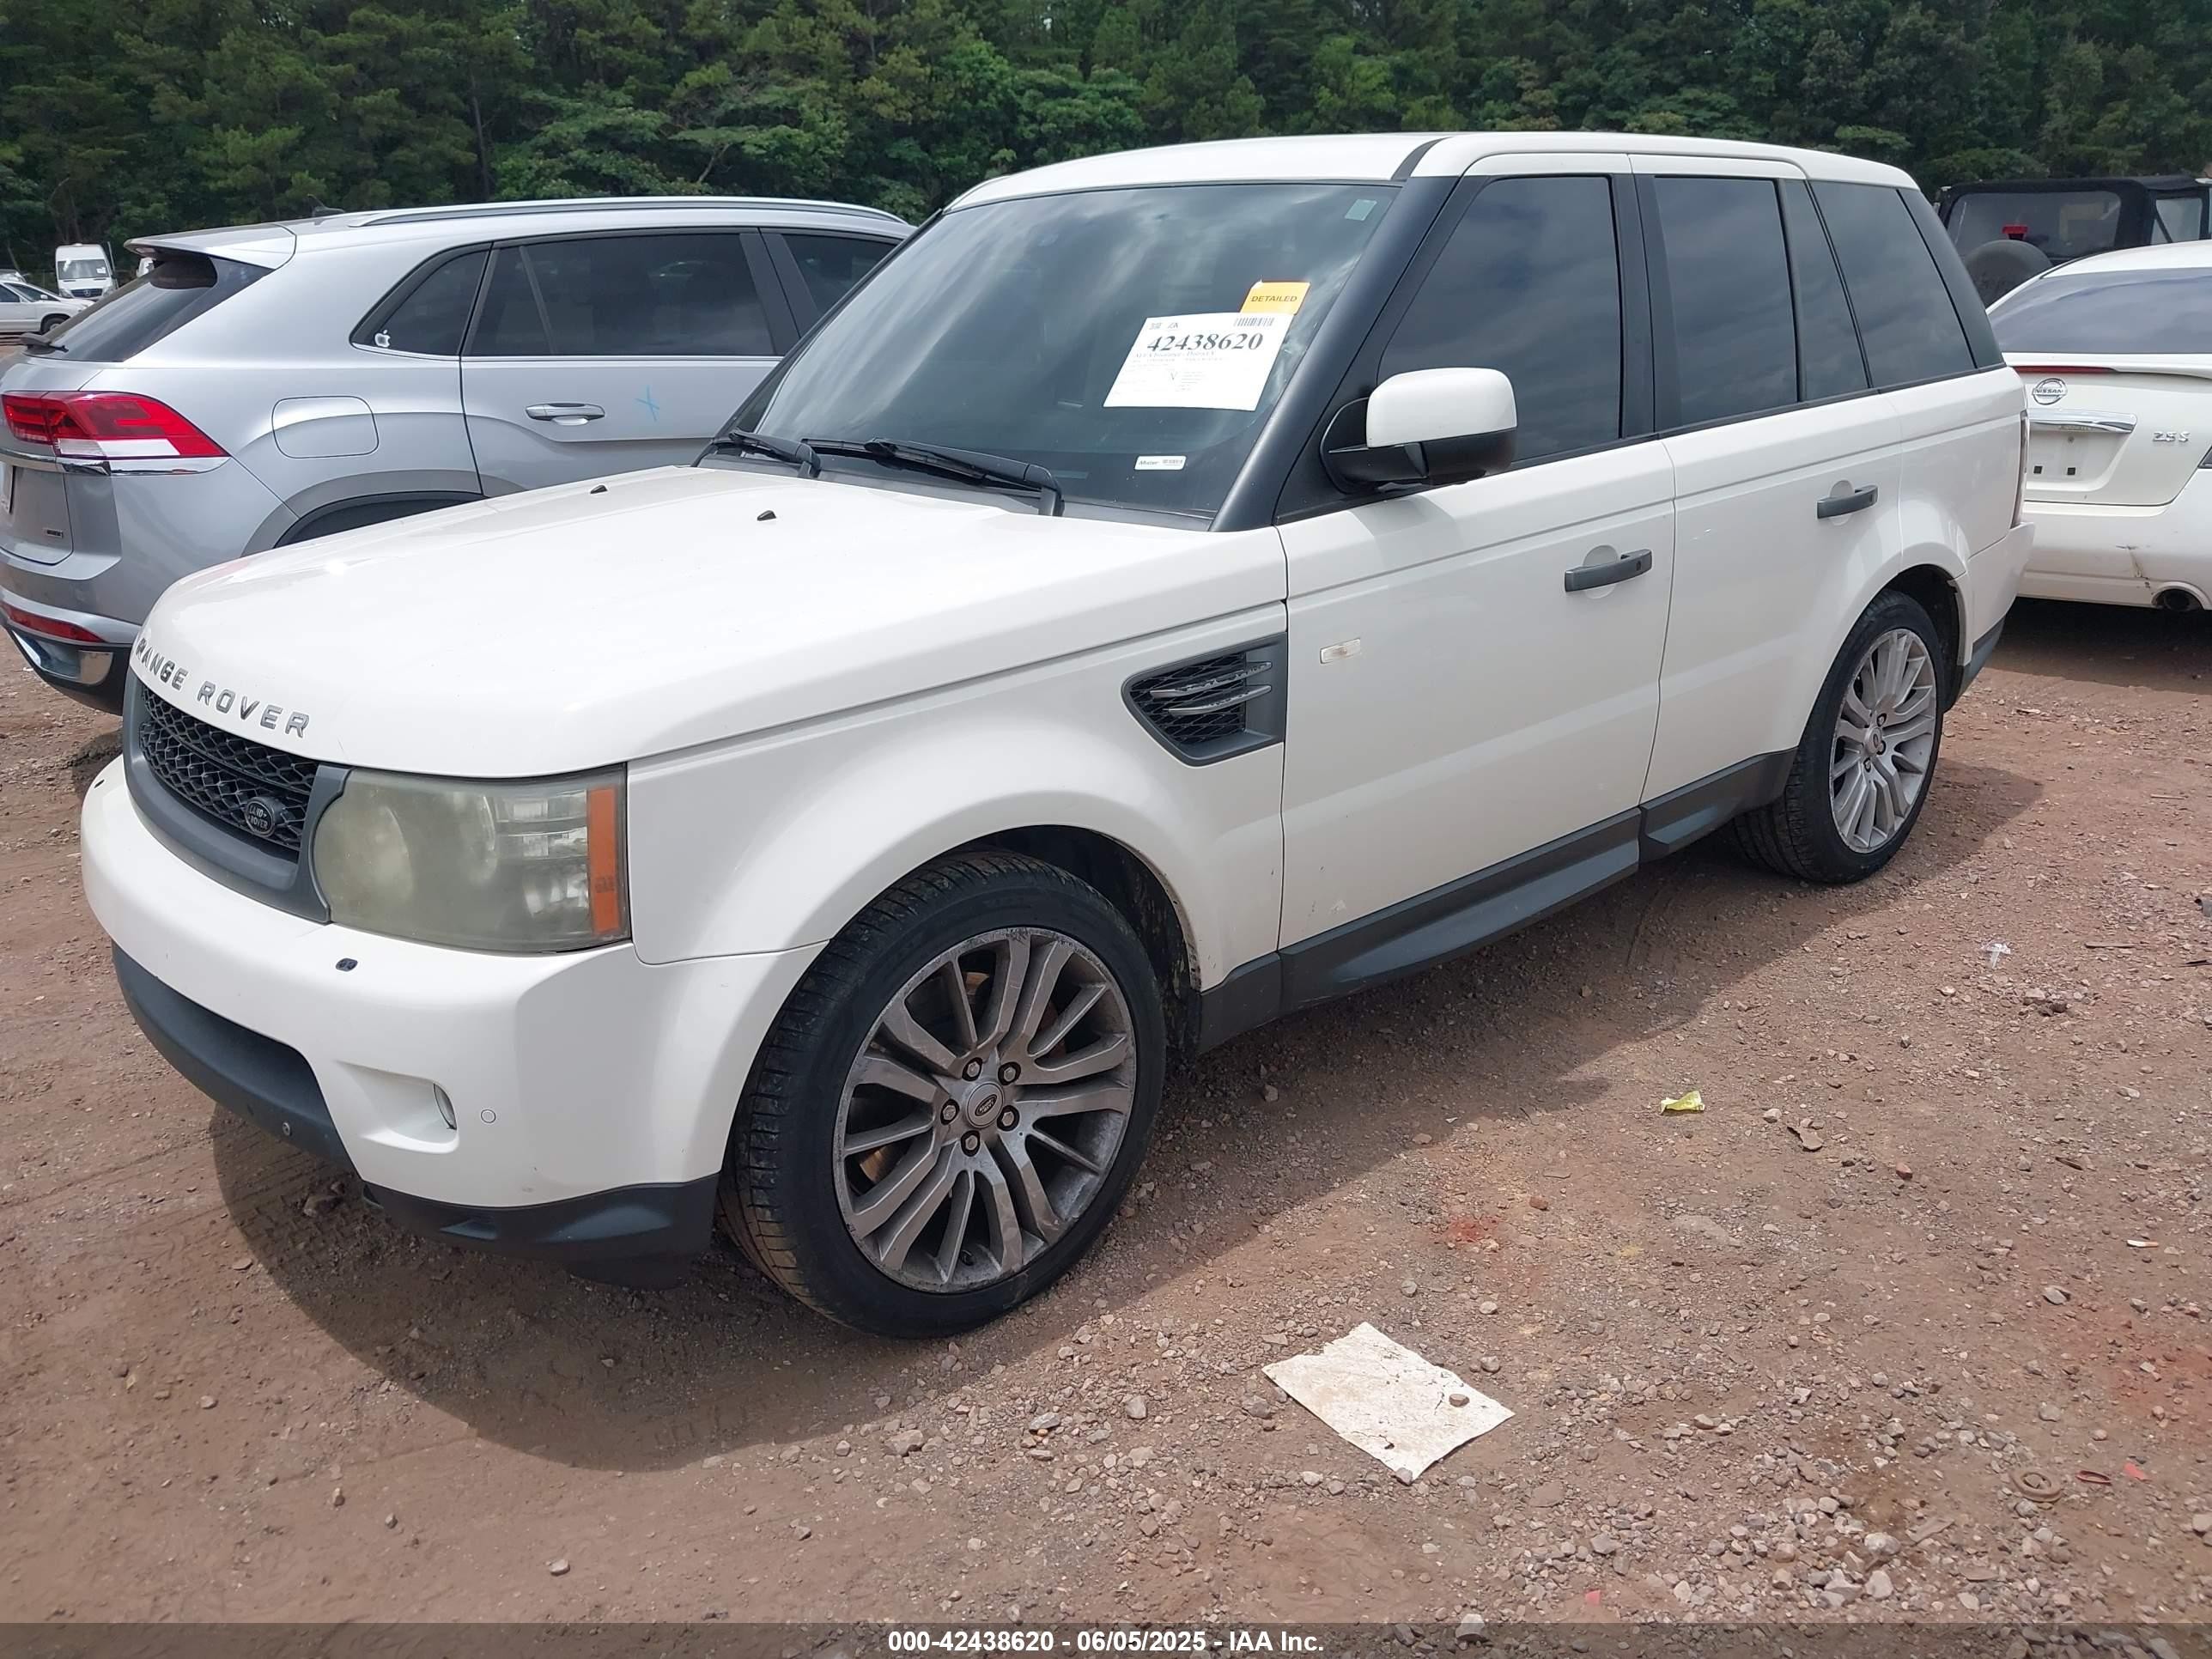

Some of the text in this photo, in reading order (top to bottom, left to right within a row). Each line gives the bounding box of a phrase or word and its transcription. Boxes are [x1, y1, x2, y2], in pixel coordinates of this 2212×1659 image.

[1147, 332, 1263, 352] 42438620
[135, 637, 310, 738] RANGE ROVER
